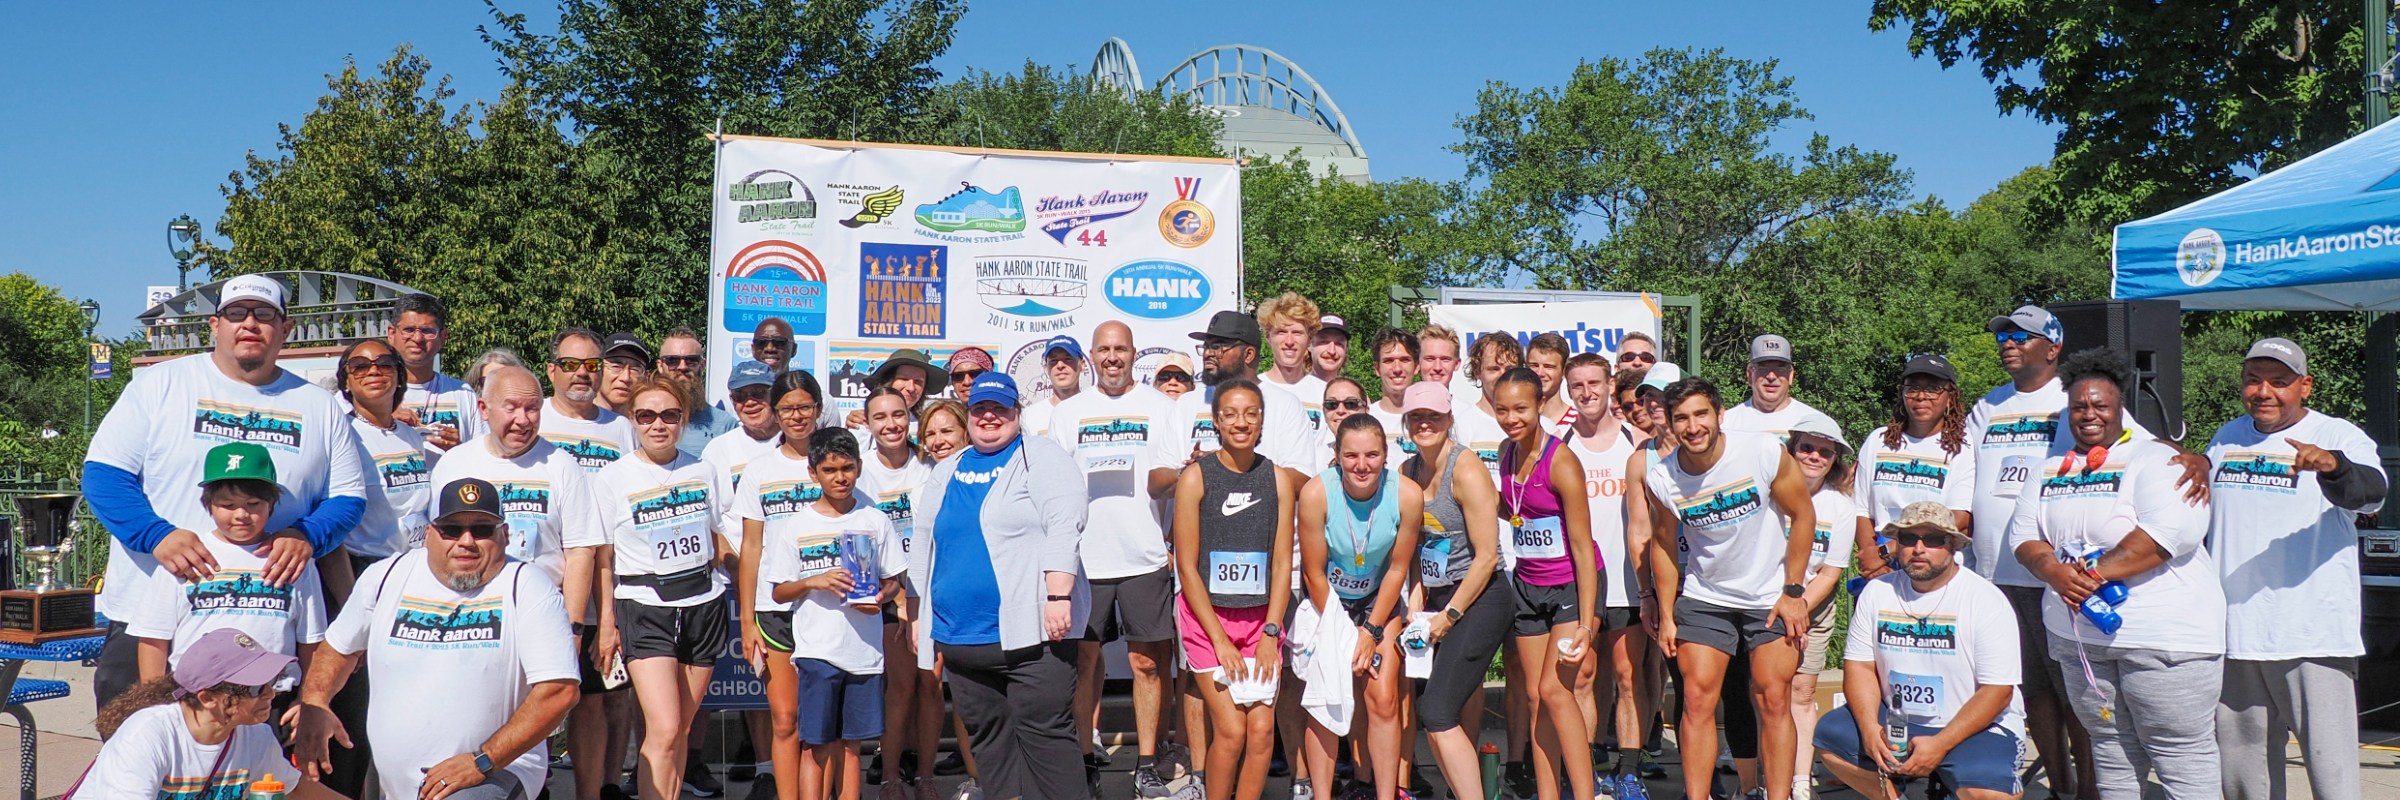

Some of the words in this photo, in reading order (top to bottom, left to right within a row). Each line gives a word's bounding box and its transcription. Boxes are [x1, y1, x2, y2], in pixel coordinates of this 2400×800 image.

[729, 181, 793, 201] HANK
[1036, 194, 1085, 212] Hank
[738, 201, 817, 223] AARON
[760, 222, 786, 231] State
[790, 220, 815, 230] Trail
[1046, 222, 1068, 231] State
[1069, 216, 1091, 228] Trail
[914, 228, 939, 240] HANK
[941, 233, 972, 243] AARON
[974, 235, 999, 243] STATE
[1000, 232, 1025, 242] TRAIL
[1077, 229, 1107, 246] 44
[976, 260, 1000, 277] HANK
[1003, 260, 1032, 276] AARON
[1035, 260, 1061, 277] STATE
[1064, 263, 1087, 281] TRAIL
[732, 282, 768, 293] HANK
[772, 285, 819, 296] AARON
[865, 280, 924, 303] HANK
[1112, 277, 1202, 298] HANK
[736, 295, 772, 306] STATE
[779, 297, 814, 308] TRAIL
[1148, 301, 1167, 310] 2018
[742, 313, 754, 321] 5K
[865, 301, 941, 324] AARON
[863, 322, 900, 335] STATE
[905, 324, 941, 336] TRAIL
[987, 313, 1008, 329] 2011
[1014, 320, 1025, 332] 5K
[1029, 315, 1075, 333] RUN/WALK
[1010, 354, 1024, 375] HANK
[1023, 343, 1045, 358] AARO
[201, 420, 244, 440] hank
[246, 430, 294, 445] aaron
[1082, 432, 1111, 443] hank
[1111, 432, 1143, 442] aaron
[1985, 432, 2013, 443] hank
[2013, 432, 2048, 442] aaron
[390, 472, 417, 487] hank
[1587, 468, 1612, 478] THE
[1876, 470, 1905, 482] hank
[1905, 475, 1940, 488] aaron
[2217, 471, 2249, 483] hank
[2249, 474, 2292, 487] aaron
[2043, 484, 2076, 497] hank
[2076, 482, 2114, 493] aaron
[502, 501, 543, 512] aaron
[1227, 492, 1252, 505] NIKE
[638, 505, 675, 524] hank
[764, 501, 795, 515] hank
[1687, 512, 1721, 528] hank
[1721, 500, 1757, 521] aaron
[1517, 529, 1553, 546] 3668
[657, 535, 701, 560] 2136
[801, 555, 833, 570] hank
[1218, 563, 1259, 581] 3671
[1328, 572, 1370, 589] 3636
[194, 593, 236, 608] hank
[237, 596, 285, 609] aaron
[396, 623, 442, 641] hank
[443, 627, 493, 642] aaron
[1881, 632, 1915, 647] hank
[1916, 638, 1950, 648] aaron
[733, 664, 745, 675] IN
[1894, 683, 1934, 704] 3323
